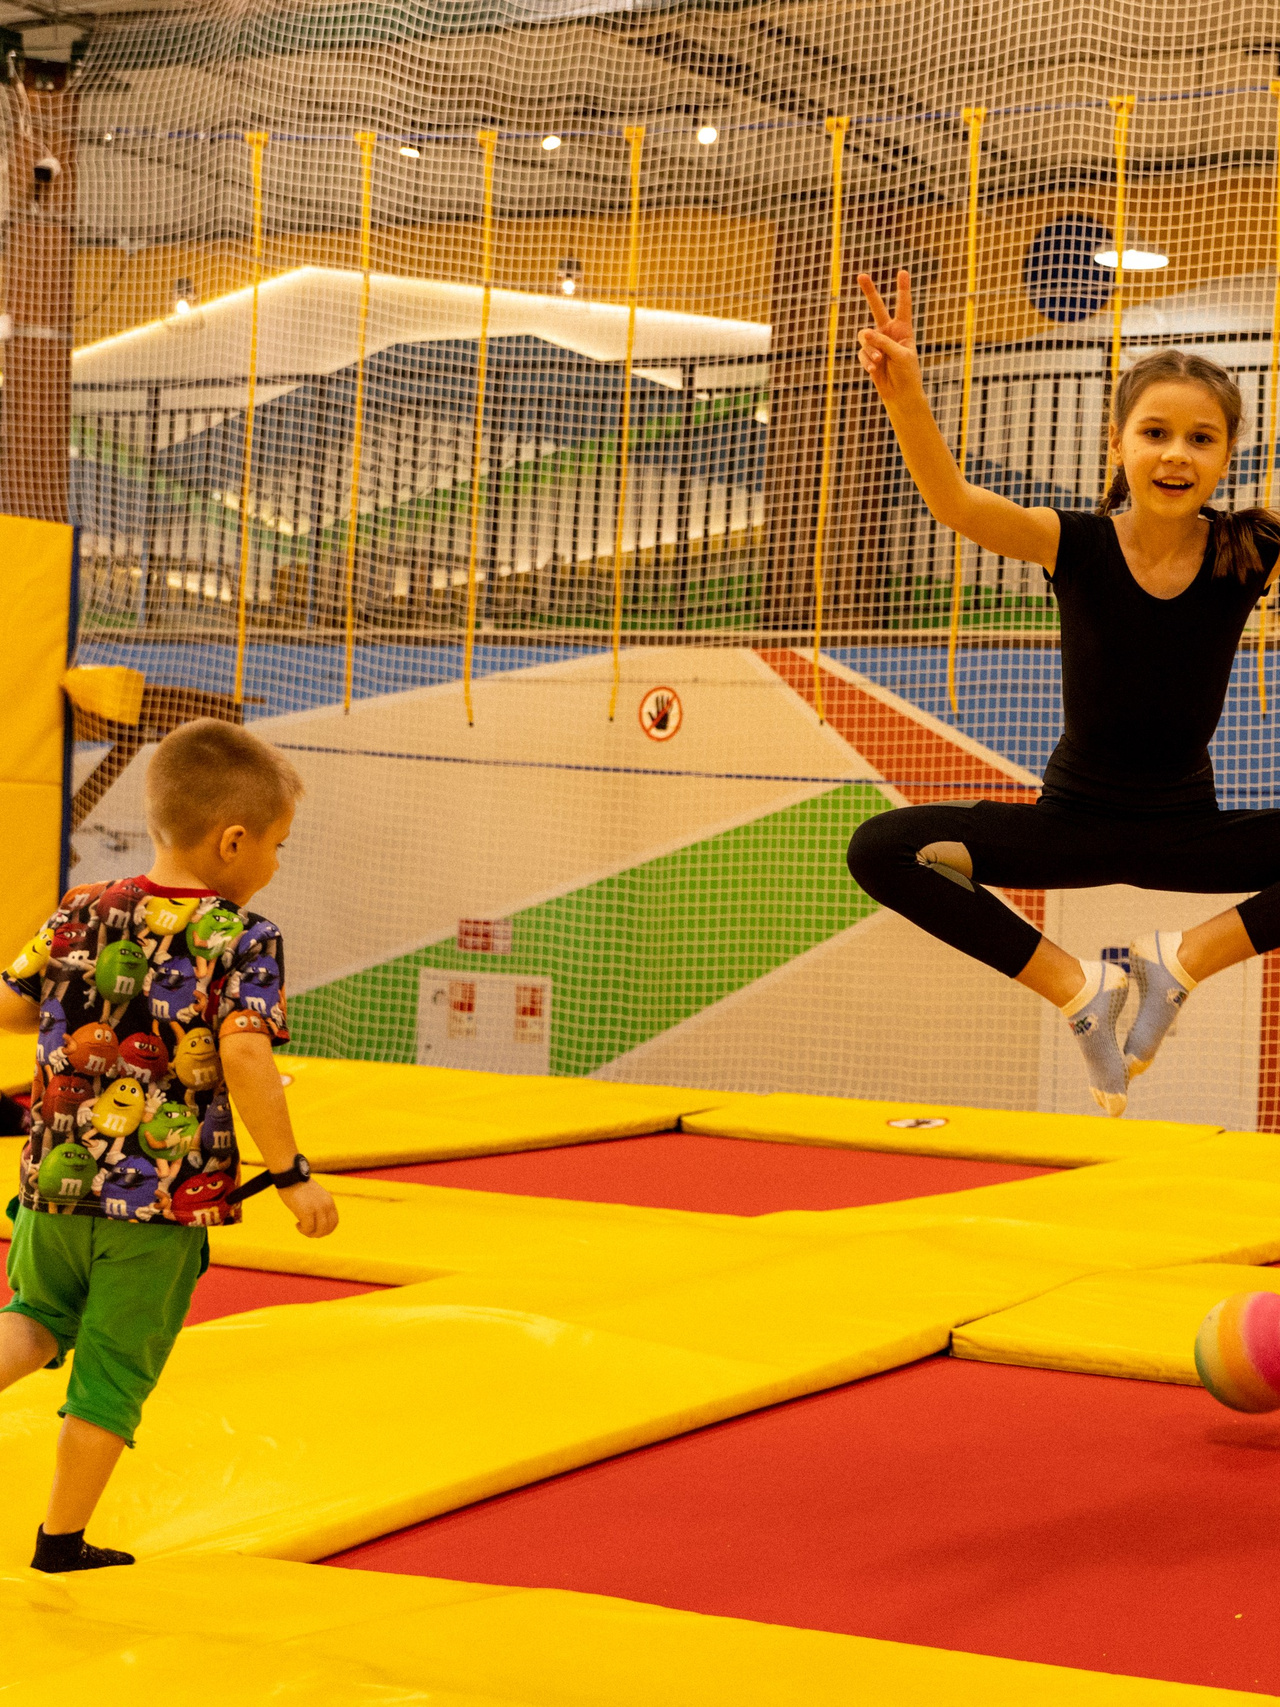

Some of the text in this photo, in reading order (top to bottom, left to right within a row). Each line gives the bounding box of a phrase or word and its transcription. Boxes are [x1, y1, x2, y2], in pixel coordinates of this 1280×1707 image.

[105, 907, 131, 929] m
[155, 910, 178, 930] m
[114, 975, 135, 995] m
[152, 999, 171, 1019] m
[245, 996, 267, 1015] m
[85, 1054, 106, 1072] m
[51, 1112, 74, 1132] m
[102, 1113, 127, 1133] m
[212, 1131, 231, 1149] m
[58, 1178, 82, 1196] m
[105, 1197, 129, 1217] m
